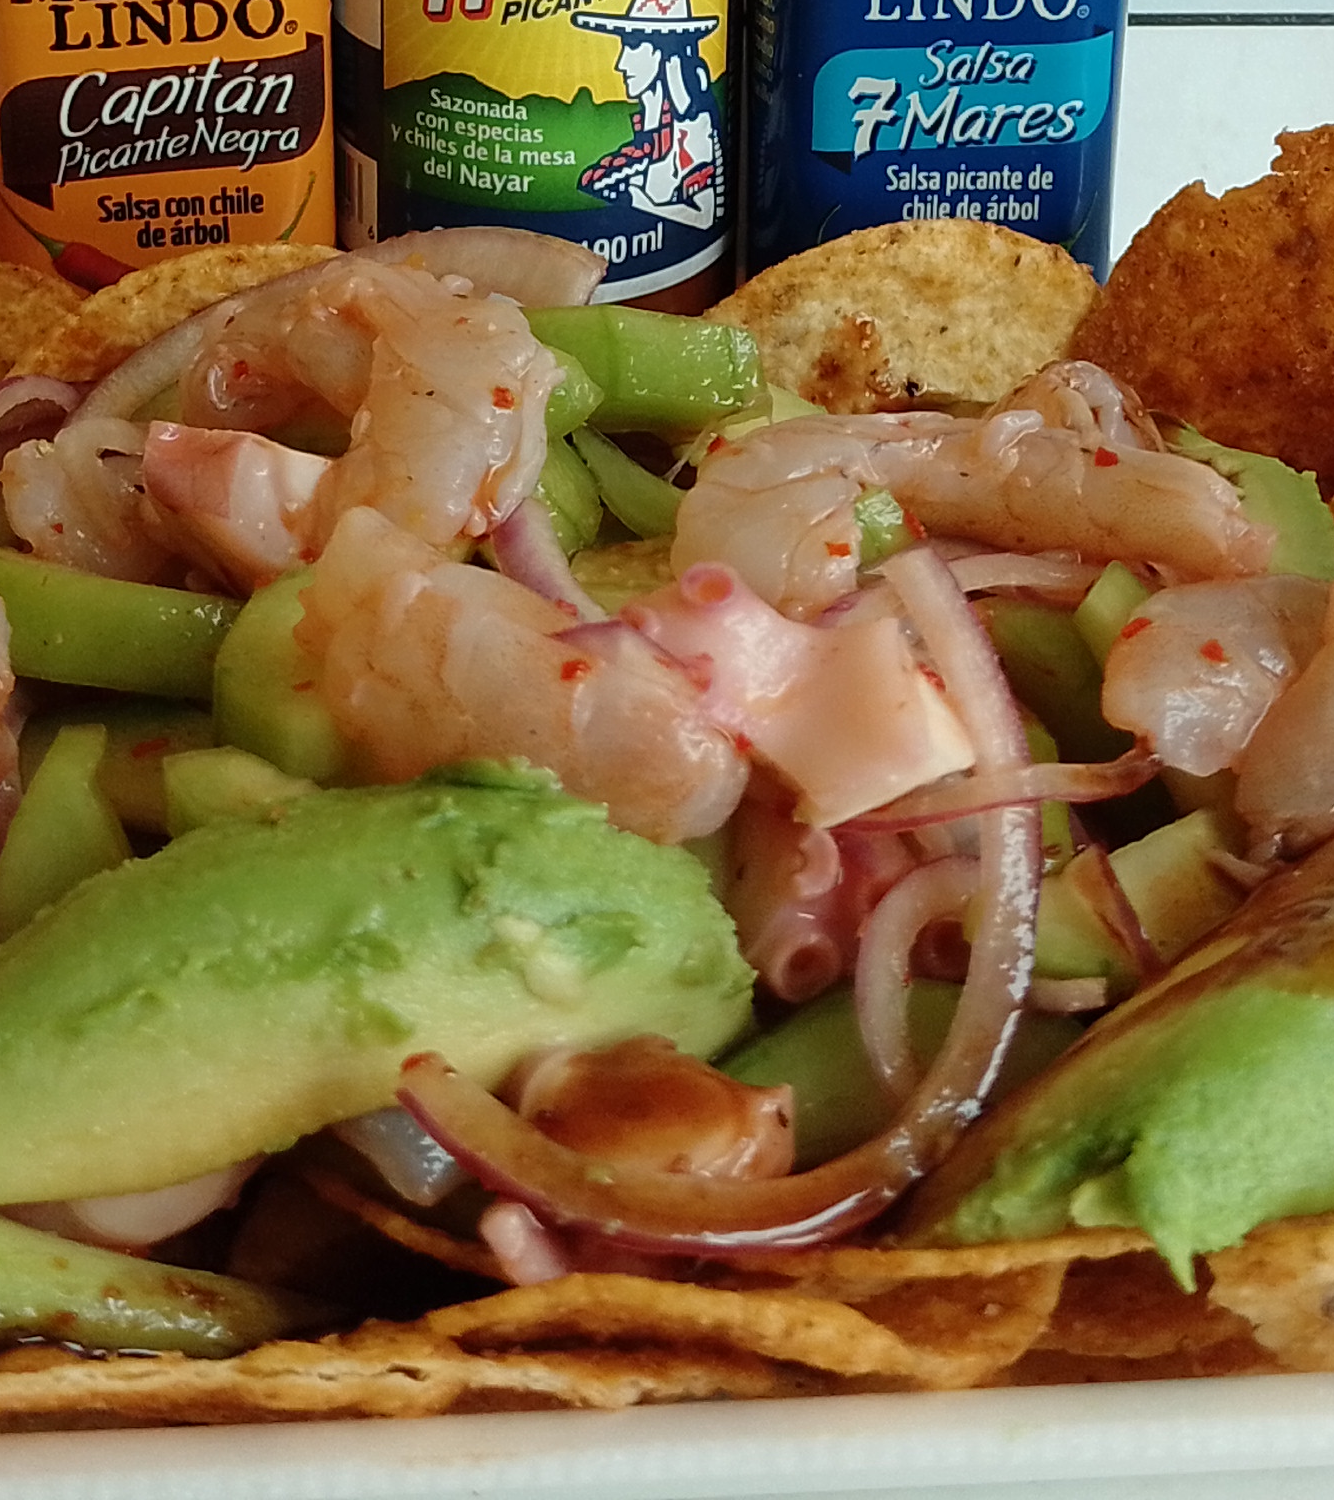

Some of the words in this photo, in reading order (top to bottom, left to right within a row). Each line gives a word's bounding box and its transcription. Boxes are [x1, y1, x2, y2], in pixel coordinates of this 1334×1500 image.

[919, 40, 1037, 86] Salsa
[59, 56, 294, 138] Capitán
[430, 88, 528, 121] Sazonada
[415, 109, 449, 134] con
[455, 117, 544, 145] especias
[848, 77, 897, 162] 7
[901, 88, 1084, 150] Mares
[391, 122, 402, 142] y
[405, 127, 459, 157] chiles
[463, 138, 489, 163] de
[494, 142, 513, 164] la
[519, 148, 576, 166] mesa
[423, 156, 453, 180] del
[459, 163, 535, 196] Nayar
[887, 165, 940, 191] Salsa
[945, 165, 1024, 196] picante
[1030, 165, 1053, 190] de
[98, 192, 161, 225] Salsa
[165, 194, 205, 219] con
[209, 187, 264, 215] chile
[902, 198, 951, 222] chile
[956, 197, 982, 220] de
[988, 195, 1039, 221] árbol
[137, 220, 167, 248] de
[171, 217, 231, 247] árbol
[631, 222, 663, 257] ml
